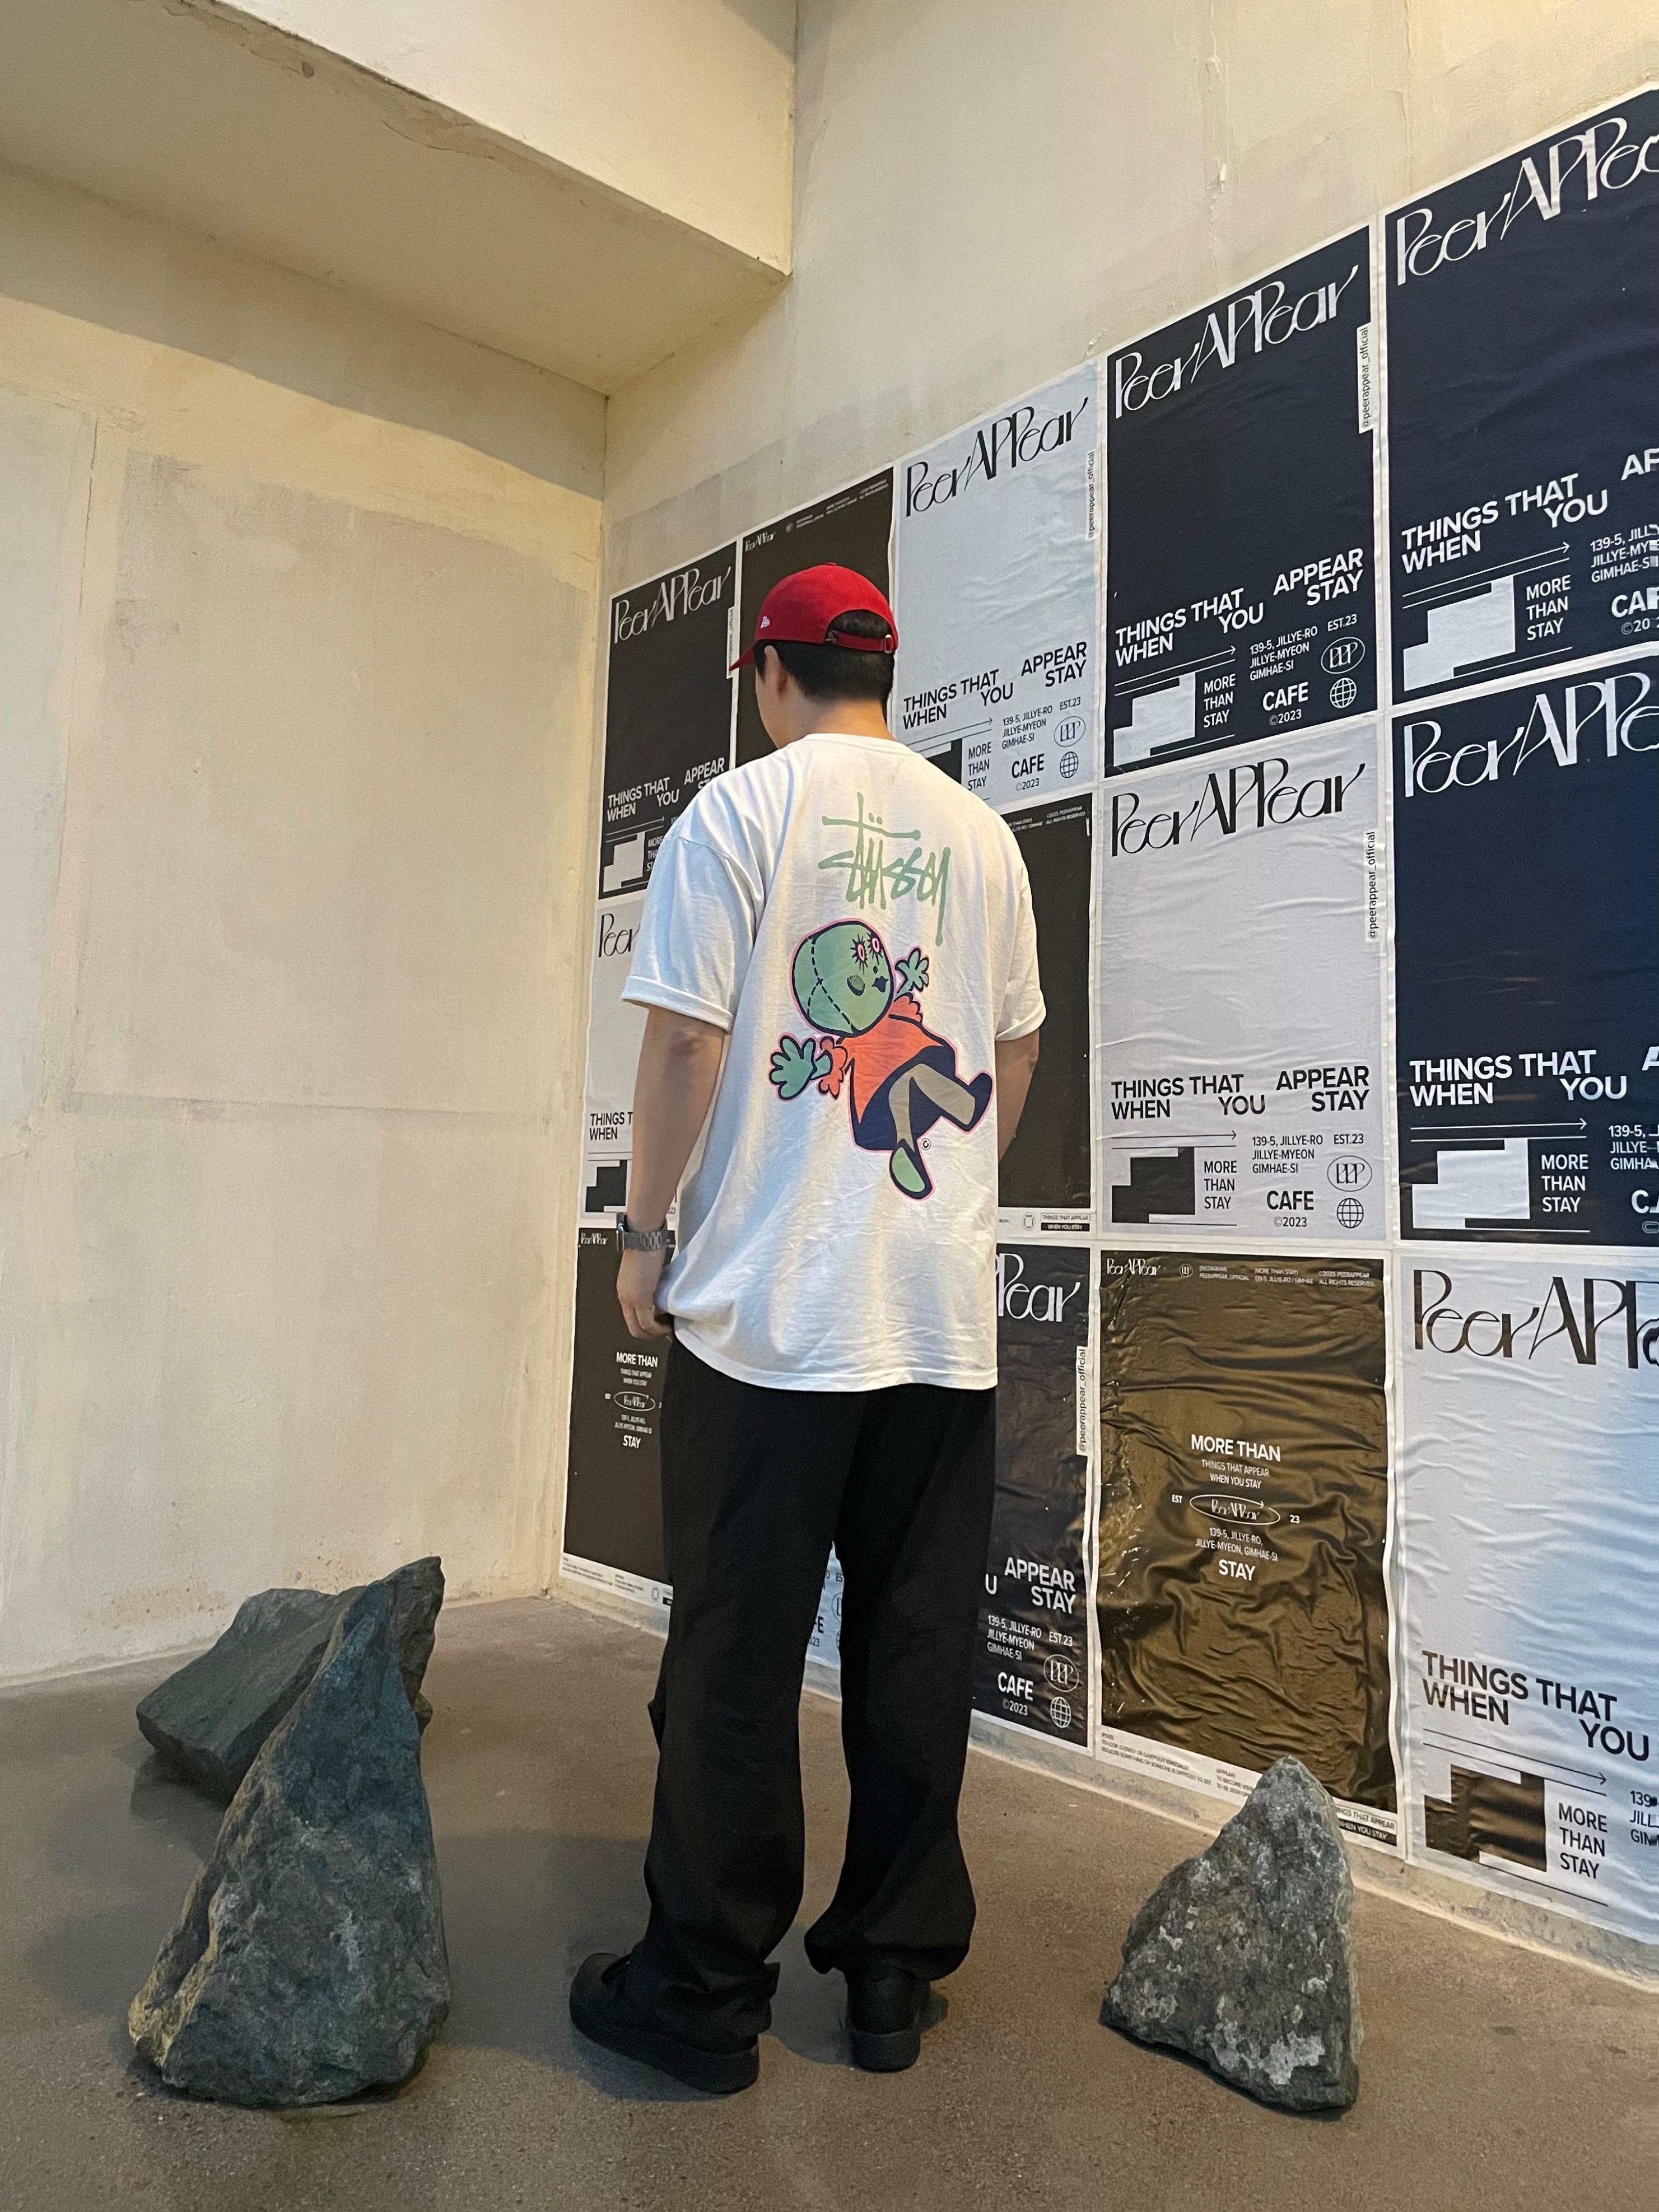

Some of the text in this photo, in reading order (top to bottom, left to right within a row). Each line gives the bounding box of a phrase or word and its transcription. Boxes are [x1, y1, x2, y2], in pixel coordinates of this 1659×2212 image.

[1362, 327, 1372, 428] @peerappear_official
[1401, 473, 1578, 550] THINGS THAT
[1401, 489, 1607, 574] WHEN YOU
[1590, 533, 1625, 552] 139-5,
[1116, 548, 1363, 646] THINGS THAT APPEAR
[1526, 575, 1571, 601] MORE
[1116, 570, 1363, 666] WHEN YOU STAY
[1526, 596, 1568, 620] THAN
[1327, 614, 1357, 632] EST.23
[1527, 618, 1564, 641] STAY
[1250, 626, 1317, 655] 139-5, JILLYE-RO
[1250, 642, 1310, 668] JILLYE-MYEON
[903, 641, 1087, 712] THINGS THAT APPEAR
[1250, 660, 1294, 681] GIMHAE-SI
[1204, 674, 1236, 694] MORE
[903, 660, 1087, 729] WHEN YOU STAY
[1060, 697, 1081, 710] EST.23
[1204, 692, 1233, 711] THAN
[1263, 682, 1308, 711] CAFE
[1003, 706, 1052, 726] 139-5, JILLYE-RO
[1204, 710, 1229, 728] STAY
[1269, 708, 1302, 725] ©2023
[1003, 718, 1046, 738] JILLYE-MYEON
[968, 741, 991, 759] MORE
[1002, 733, 1034, 749] GIMHAE-SI
[968, 759, 990, 776] THAN
[1012, 754, 1045, 778] CAFE
[608, 786, 642, 808] THINGS
[644, 777, 670, 796] THAT
[684, 758, 725, 785] APPEAR
[968, 776, 987, 791] STAY
[607, 789, 679, 822] WHEN YOU
[1368, 832, 1379, 939] @peerappear_official
[1410, 1050, 1596, 1082] THINGS THAT
[1111, 1066, 1369, 1099] THINGS THAT APPEAR
[1410, 1076, 1627, 1107] WHEN YOU
[1111, 1089, 1369, 1119] WHEN YOU STAY
[590, 1112, 625, 1126] THINGS
[590, 1127, 617, 1140] WHEN
[1252, 1135, 1323, 1147] 139-5, JILLYE-RO
[1334, 1134, 1364, 1145] EST.23
[1609, 1125, 1646, 1138] 139-5,
[1252, 1149, 1315, 1160] JILLYE-MYEON
[1541, 1154, 1588, 1170] MORE
[1204, 1160, 1237, 1174] MORE
[1252, 1163, 1298, 1174] GIMHAE-SI
[1204, 1179, 1235, 1191] THAN
[1541, 1176, 1586, 1191] THAN
[1204, 1197, 1231, 1209] STAY
[1267, 1191, 1314, 1211] CAFE
[1543, 1197, 1581, 1212] STAY
[1274, 1217, 1307, 1227] ©2023
[617, 1352, 658, 1368] MORE THAN
[1078, 1348, 1087, 1452] @peerappear_official
[623, 1435, 641, 1448] STAY
[1191, 1434, 1280, 1462] MORE THAN
[1201, 1459, 1269, 1477] THINGS THAT APPEAR
[1210, 1474, 1261, 1489] WHEN YOU STAY
[1172, 1495, 1182, 1503] EST
[1290, 1515, 1300, 1523] 23
[1210, 1528, 1229, 1539] 139-5,
[1245, 1546, 1278, 1561] GIMHAE-SI
[1005, 1557, 1076, 1592] APPEAR
[1219, 1559, 1256, 1581] STAY
[1032, 1586, 1076, 1614] STAY
[988, 1615, 1042, 1639] 139-5, JILLYE-RO
[987, 1628, 1034, 1650] JILLYE-MYEON
[1049, 1631, 1073, 1646] EST.23
[987, 1642, 1022, 1660] GIMHAE-SI
[998, 1672, 1033, 1701] CAFE
[1422, 1650, 1617, 1721] THINGS THAT
[1423, 1679, 1649, 1761] WHEN YOU
[1354, 1812, 1394, 1829] THAT APPEAR
[1558, 1803, 1608, 1832] MORE
[1340, 1822, 1387, 1840] HEN YOU STAY
[1559, 1827, 1605, 1857] THAN
[1560, 1852, 1599, 1879] STAY
